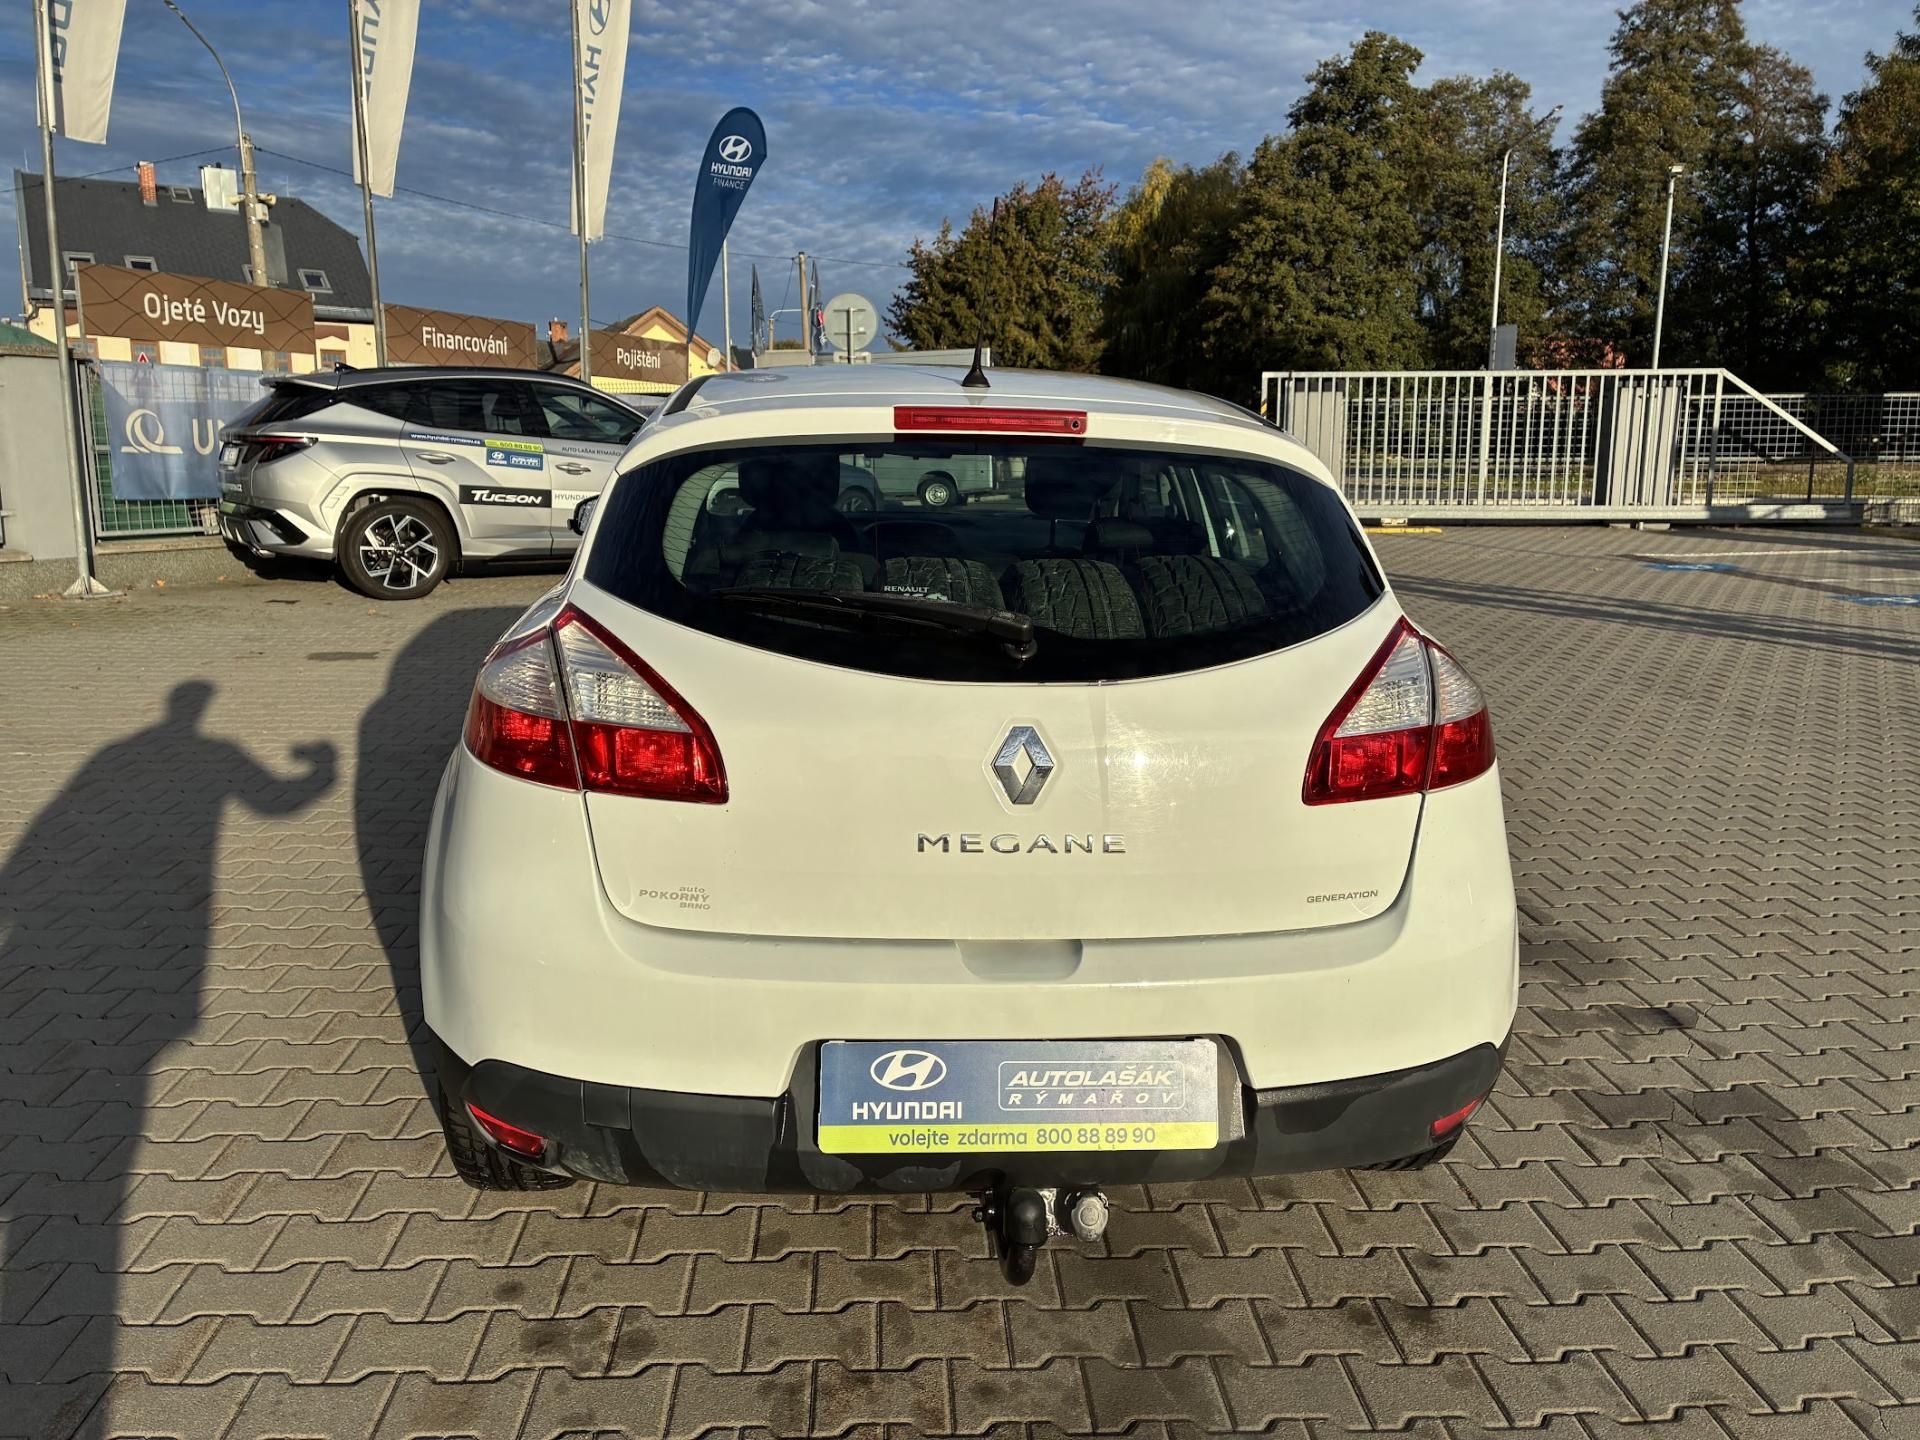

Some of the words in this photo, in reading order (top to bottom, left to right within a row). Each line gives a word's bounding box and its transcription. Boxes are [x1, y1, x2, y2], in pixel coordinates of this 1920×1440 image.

[711, 162, 752, 177] HYUNDAI
[713, 178, 745, 190] FINANCE
[144, 292, 206, 325] Ojeté
[212, 300, 265, 335] Vozy
[422, 326, 508, 355] Financování
[617, 347, 661, 369] Pojištění
[884, 585, 930, 593] RENAULT
[917, 833, 1126, 854] MEGANE
[679, 901, 711, 910] BRNO
[1306, 889, 1379, 903] GENERATION
[1008, 1065, 1172, 1086] AUTOLAŠÁK
[1009, 1089, 1175, 1105] RÝMAŘOV
[852, 1101, 962, 1120] HYUNDAI
[889, 1129, 950, 1148] volejte
[957, 1129, 1028, 1146] zdarma
[1036, 1128, 1073, 1145] 800
[1077, 1128, 1101, 1145] 88
[1105, 1128, 1129, 1144] 89
[1132, 1127, 1156, 1144] 90
